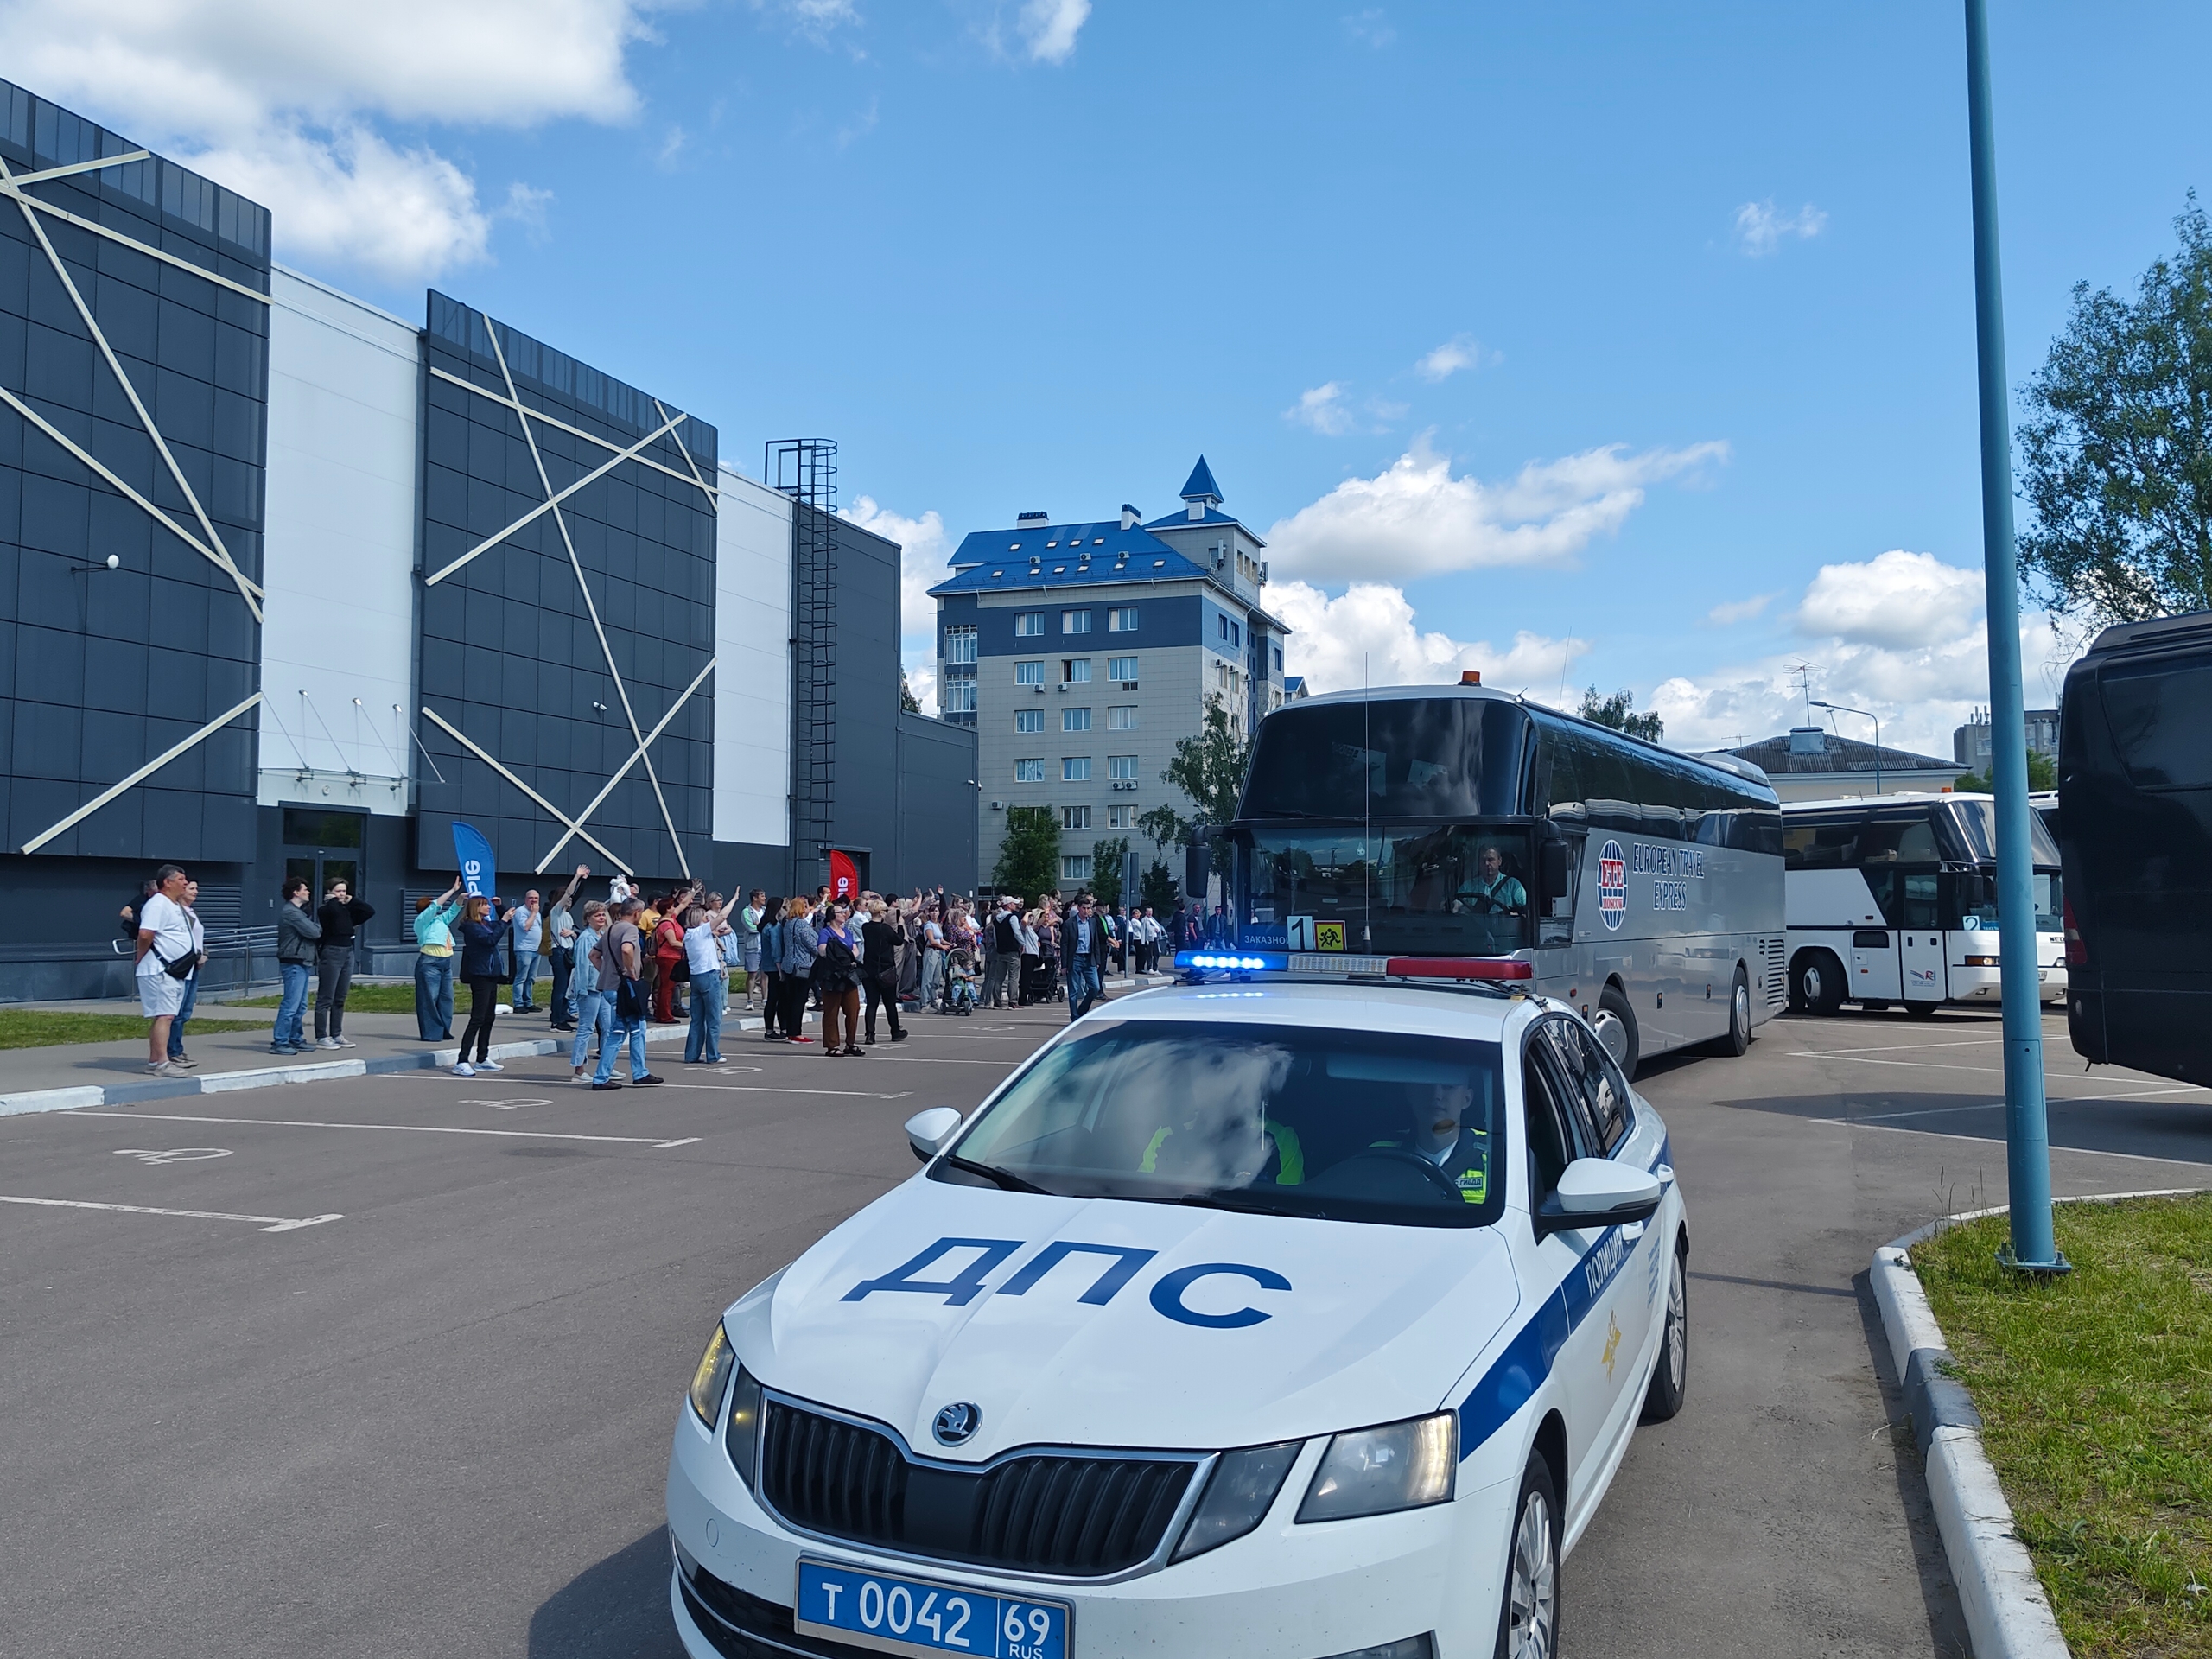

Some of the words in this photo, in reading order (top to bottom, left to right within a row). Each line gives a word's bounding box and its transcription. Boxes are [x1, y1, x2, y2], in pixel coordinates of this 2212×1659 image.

[1632, 842, 1677, 876] EUROPEAN
[1679, 848, 1705, 879] TRAVEL
[1653, 880, 1687, 911] EXPRESS
[1291, 918, 1306, 950] 1
[1585, 1225, 1624, 1298] ПОЛИЦИЯ
[840, 1236, 1292, 1329] ДПС
[859, 1581, 971, 1647] 0042
[1004, 1605, 1050, 1645] 69
[1009, 1643, 1044, 1659] RUS
